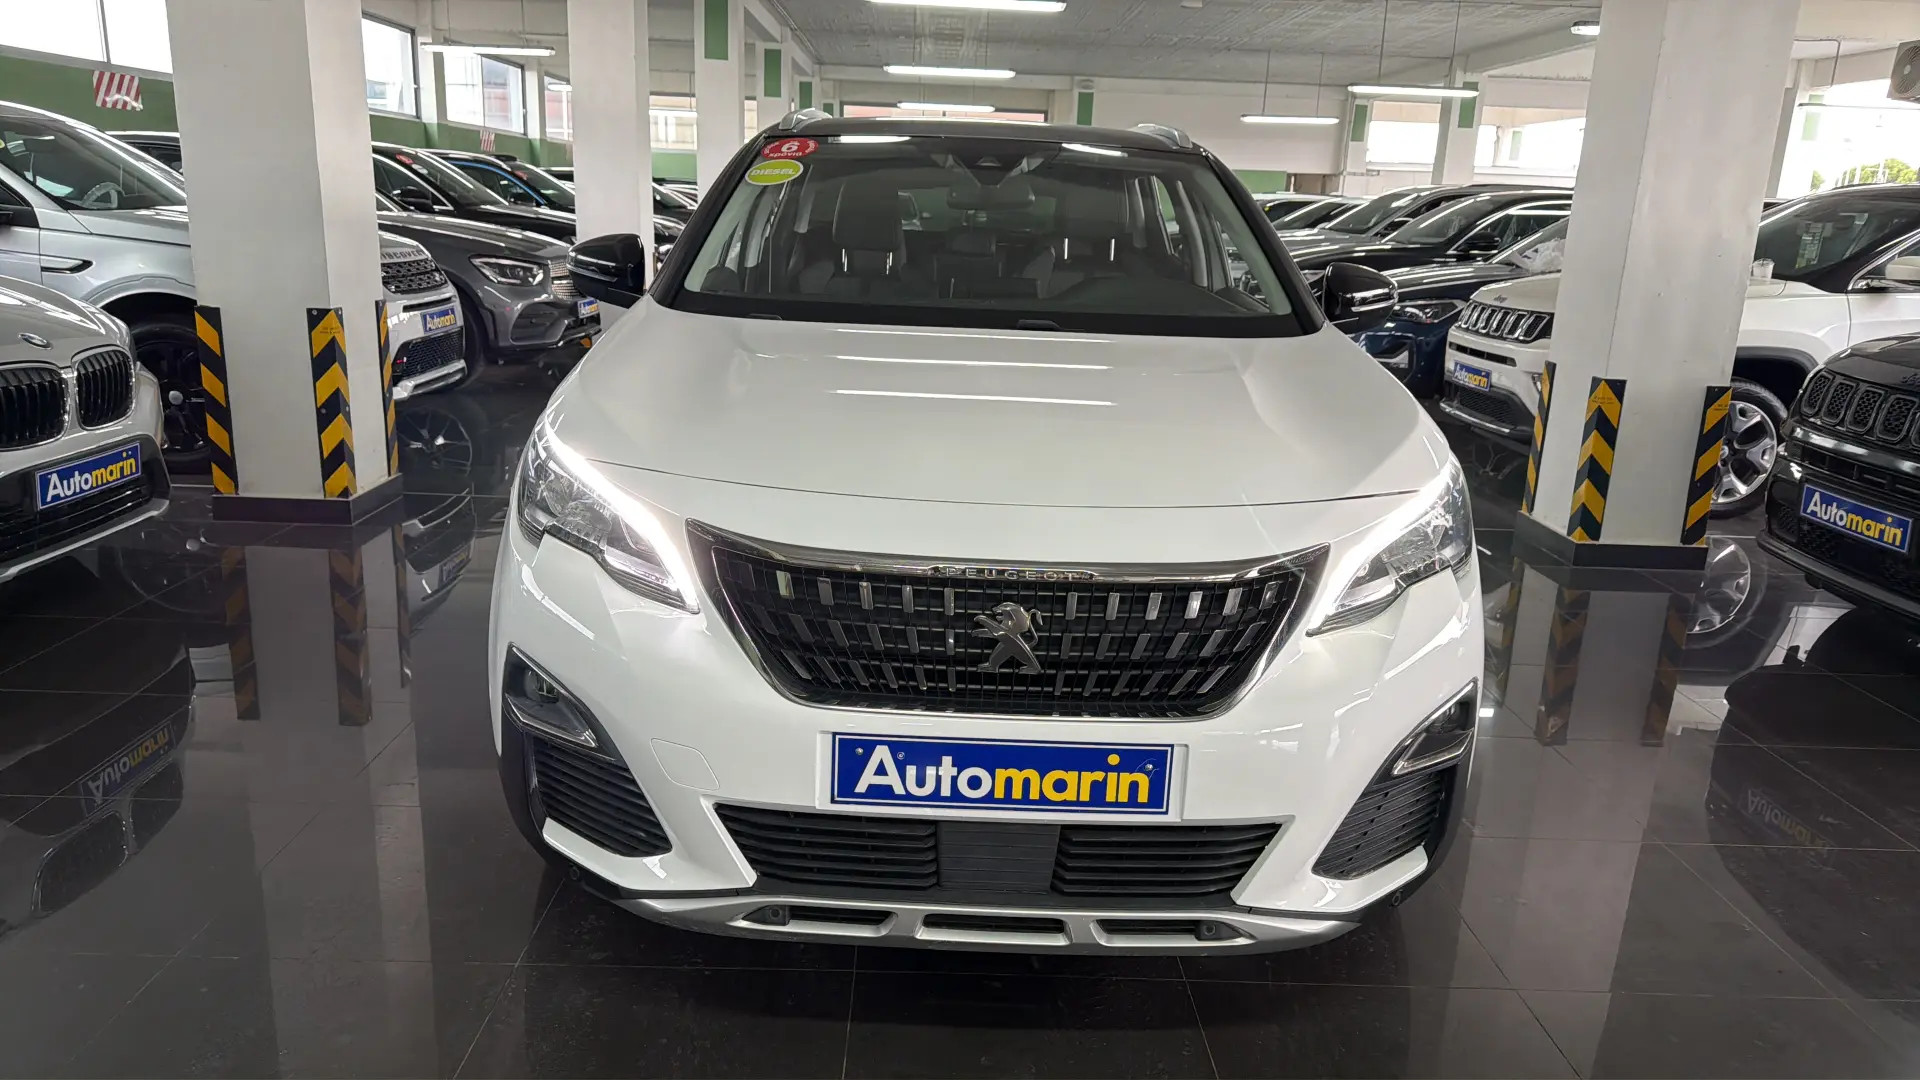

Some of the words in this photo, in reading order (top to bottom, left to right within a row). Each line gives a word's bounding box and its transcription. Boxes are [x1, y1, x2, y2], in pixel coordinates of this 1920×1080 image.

[780, 141, 801, 153] 6
[751, 168, 797, 176] DIESEL
[46, 451, 136, 502] Automarin
[1806, 491, 1903, 546] Automarin
[946, 567, 1076, 582] PEUGEOT
[854, 744, 1151, 804] Automarin
